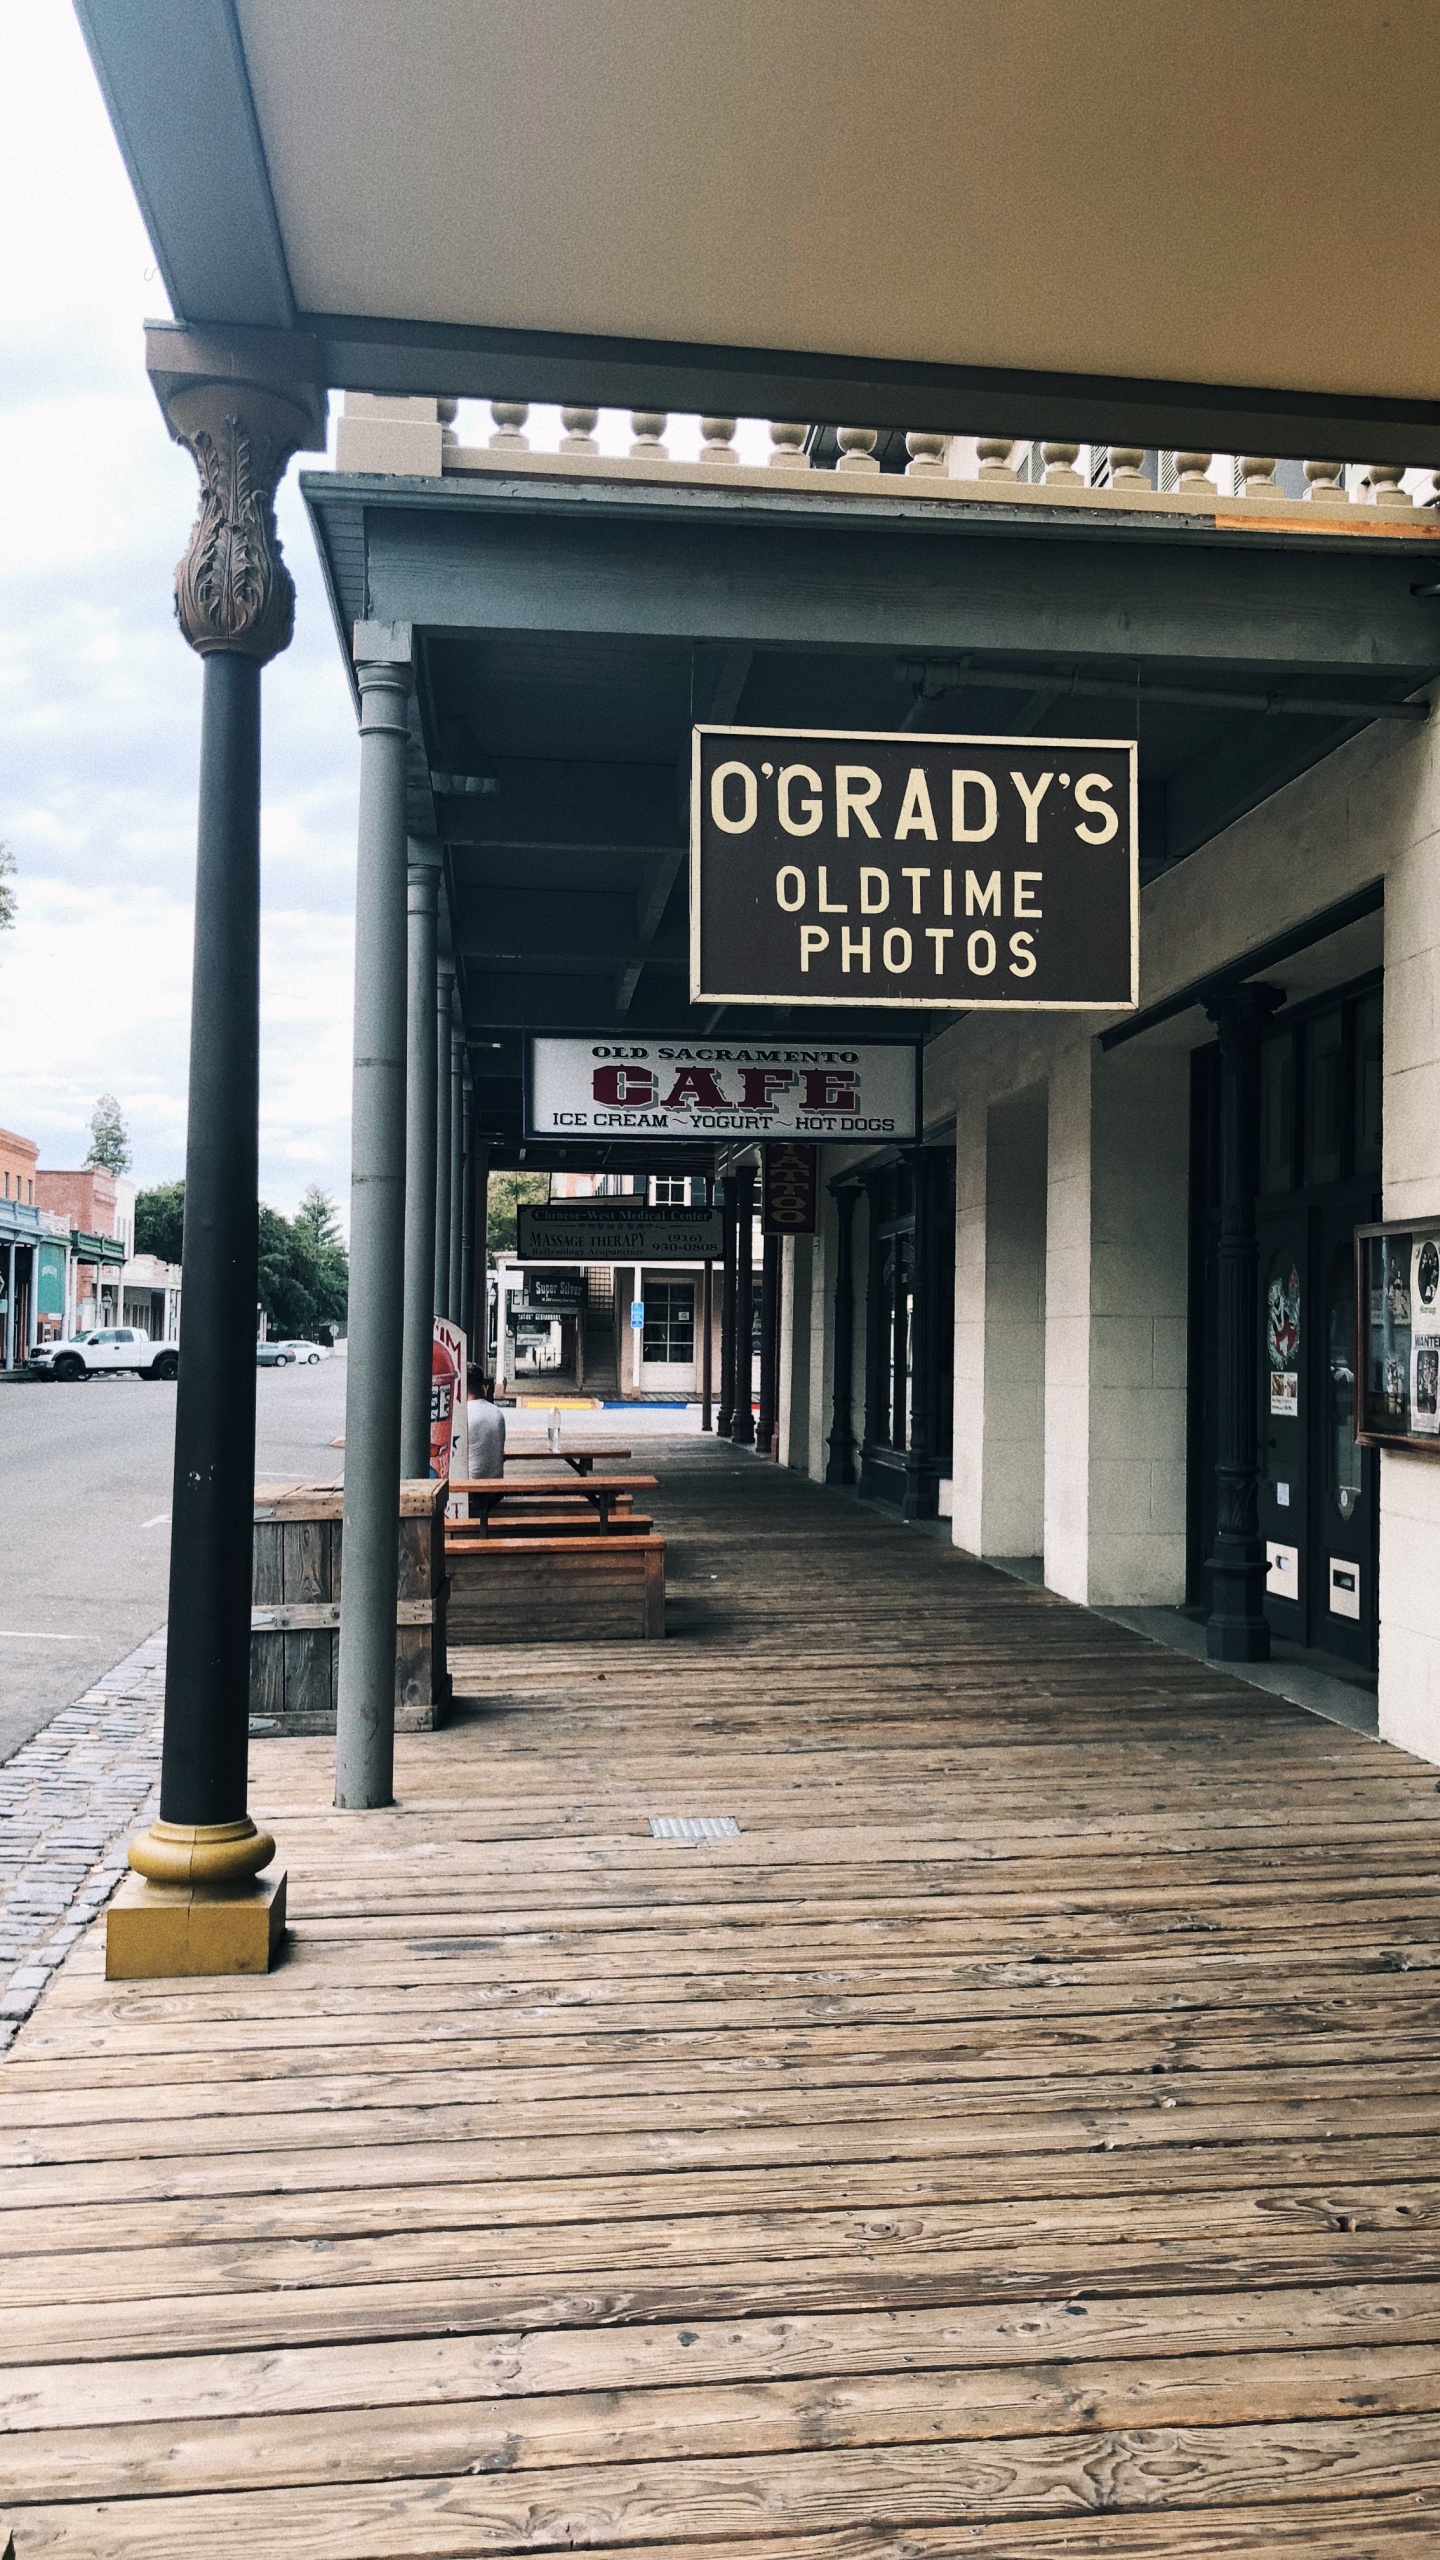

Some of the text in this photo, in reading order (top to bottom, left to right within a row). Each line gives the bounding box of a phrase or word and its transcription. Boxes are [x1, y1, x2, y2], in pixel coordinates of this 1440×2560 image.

[710, 760, 1119, 846] O'GRADY'S
[775, 865, 1043, 918] OLDTIME
[799, 925, 1037, 978] PHOTOS
[592, 1046, 859, 1063] OLD SACRAMENTO
[591, 1064, 861, 1115] CAFE
[552, 1112, 895, 1131] ICE CREAM YOGURT HOT DOGS
[534, 1209, 709, 1221] Chinese-West Medical Center
[530, 1231, 703, 1247] MASSAGE THERAPY (916)
[651, 1242, 719, 1252] 930-0808
[532, 1248, 645, 1258] Reflexology Acupuncture
[535, 1281, 583, 1297] Super Silver
[1415, 1336, 1440, 1348] WANTE
